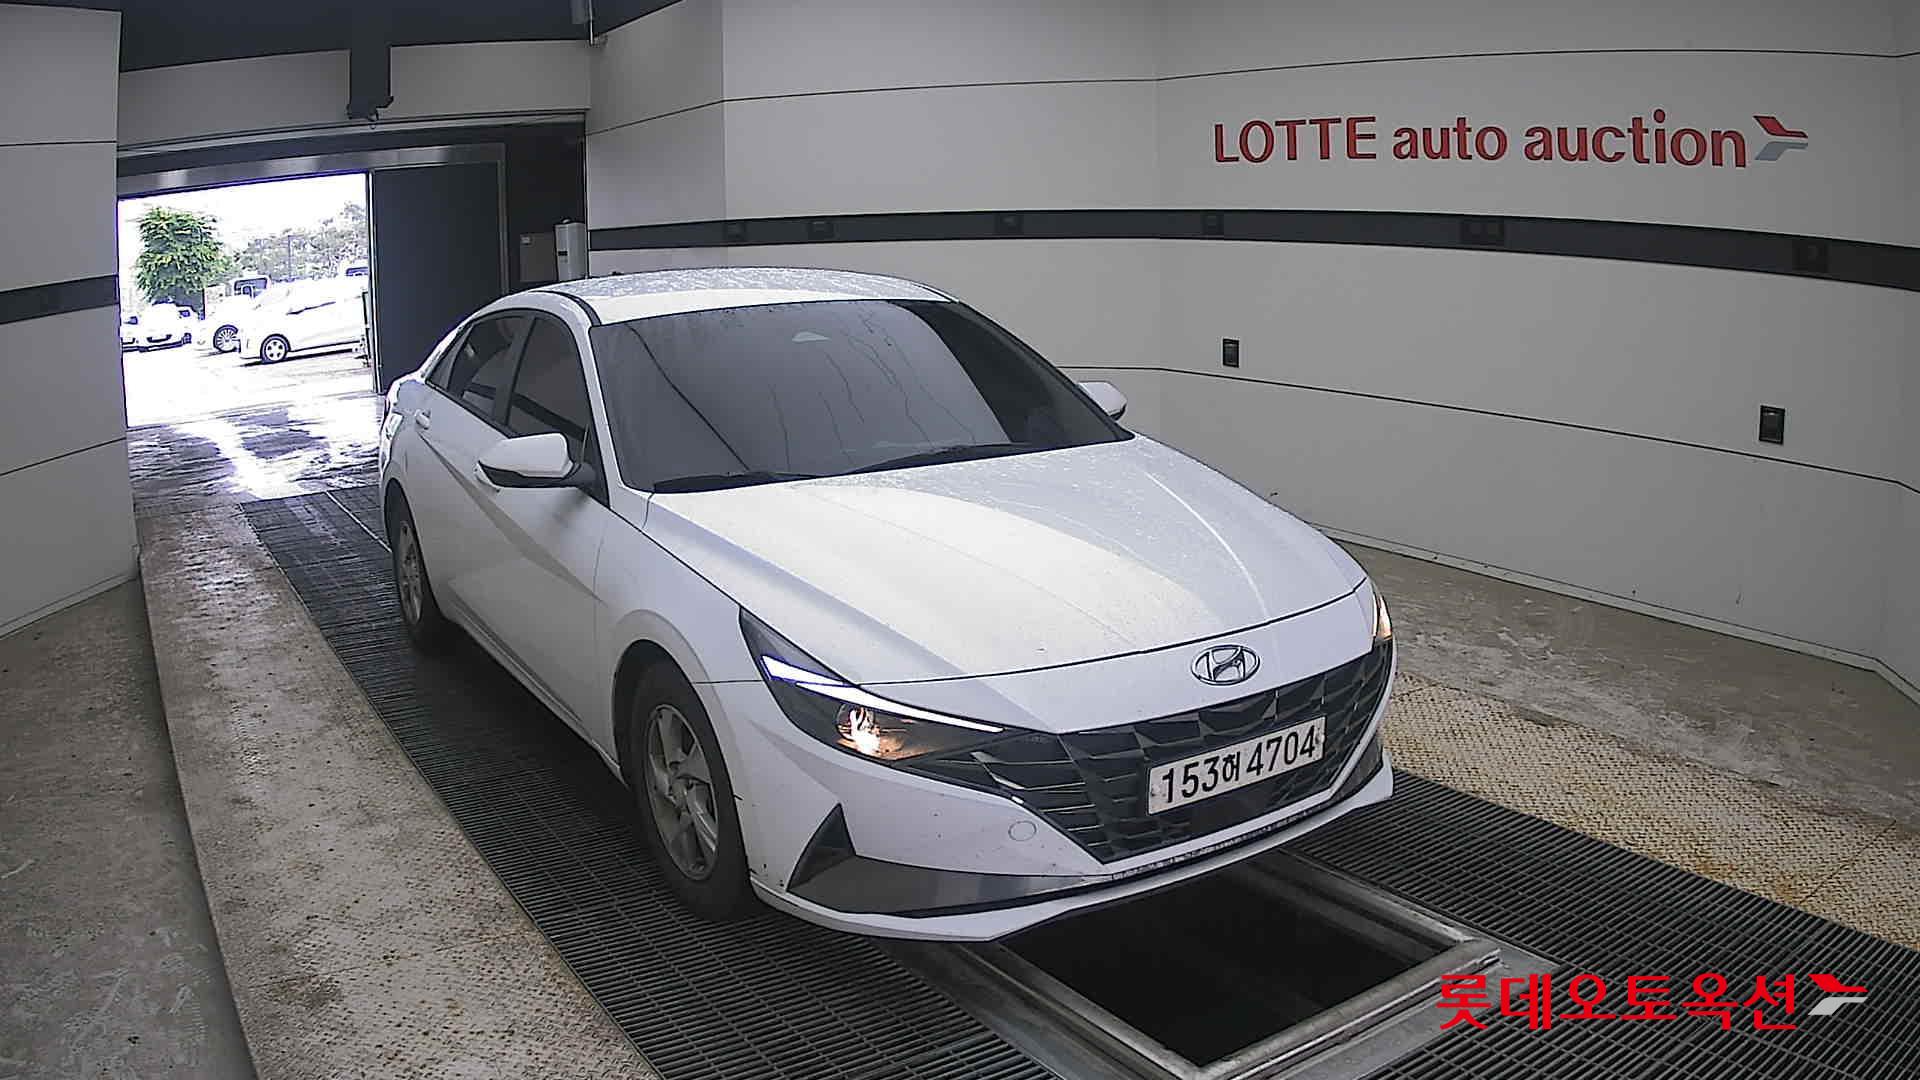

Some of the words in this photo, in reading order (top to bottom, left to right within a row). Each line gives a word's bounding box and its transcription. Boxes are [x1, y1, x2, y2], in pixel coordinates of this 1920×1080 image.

[1214, 116, 1377, 163] LOTTE
[1393, 117, 1508, 161] auto
[1524, 109, 1747, 168] auction
[1246, 725, 1316, 776] 4704
